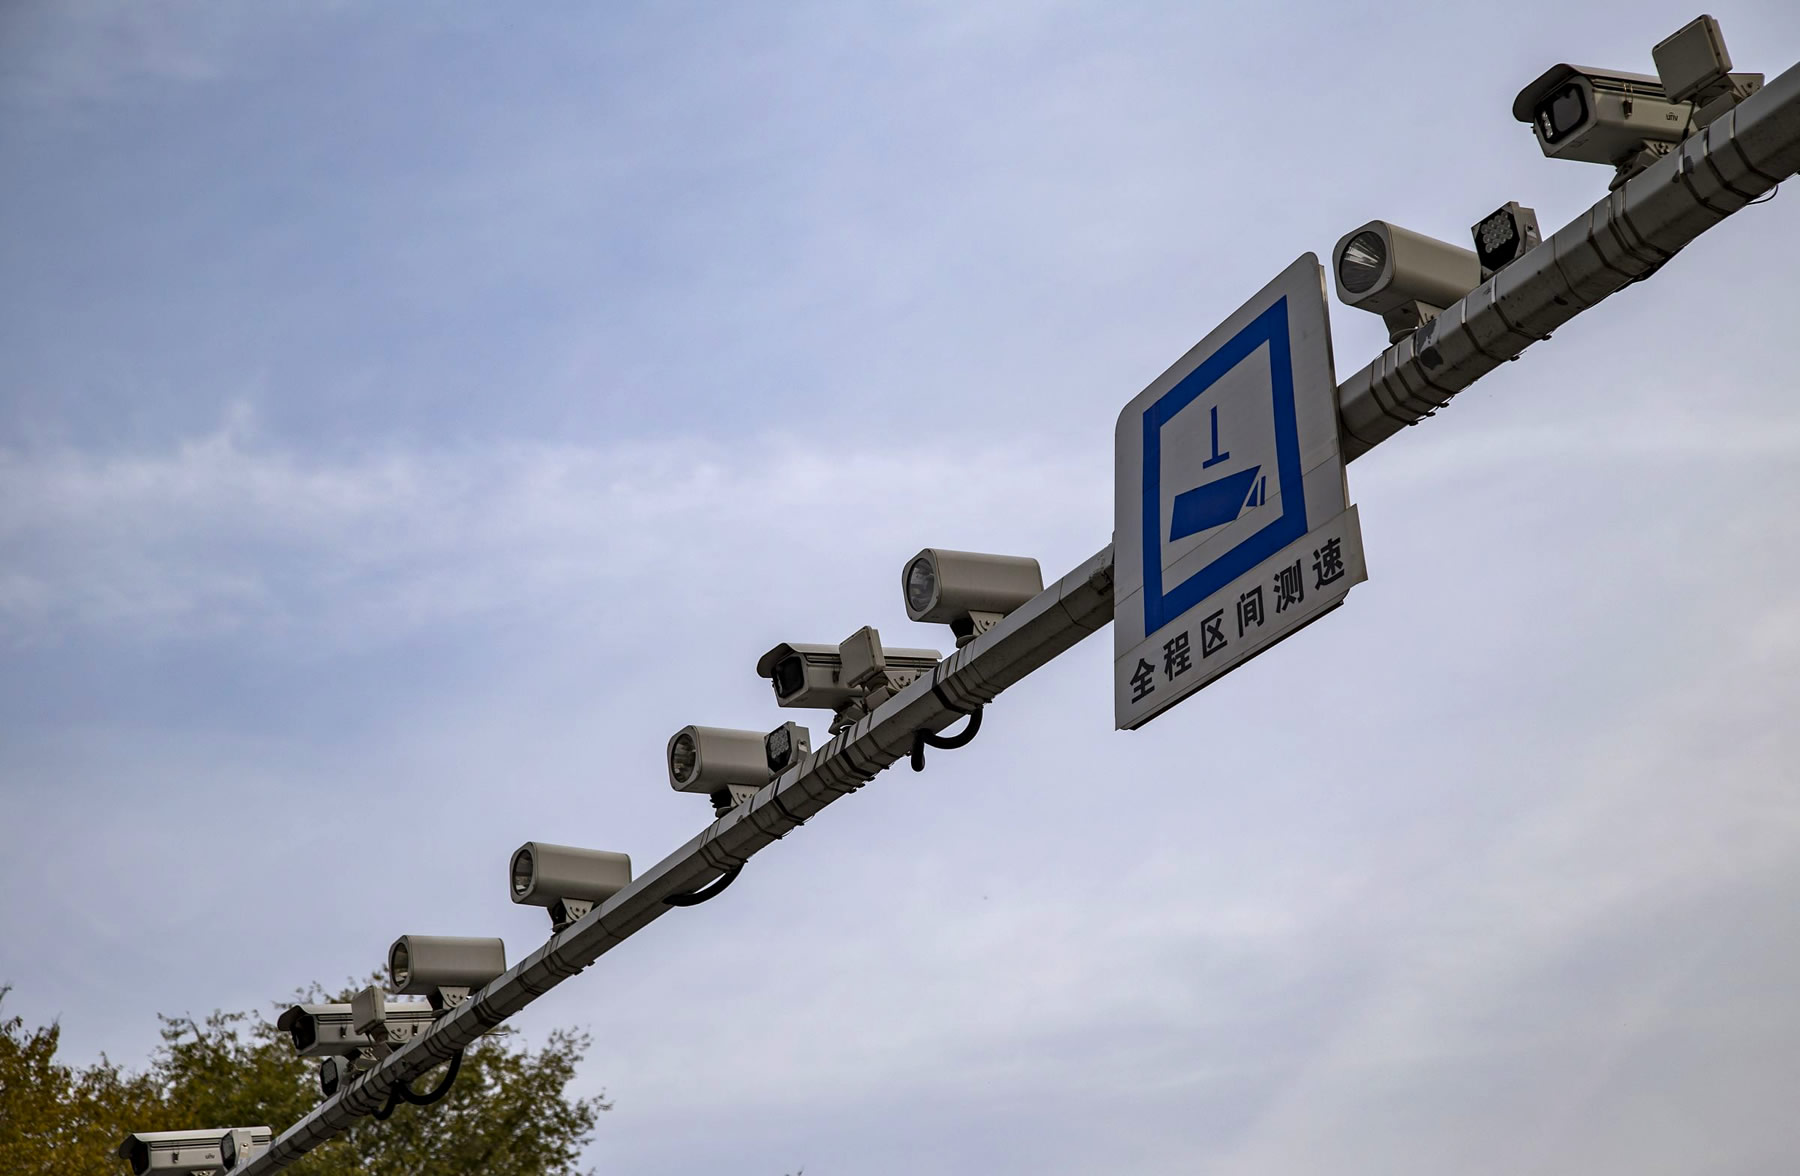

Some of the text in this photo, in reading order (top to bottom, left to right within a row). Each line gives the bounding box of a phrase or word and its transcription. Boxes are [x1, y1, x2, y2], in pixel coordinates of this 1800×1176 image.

[1130, 537, 1345, 704] 全程区间测速
